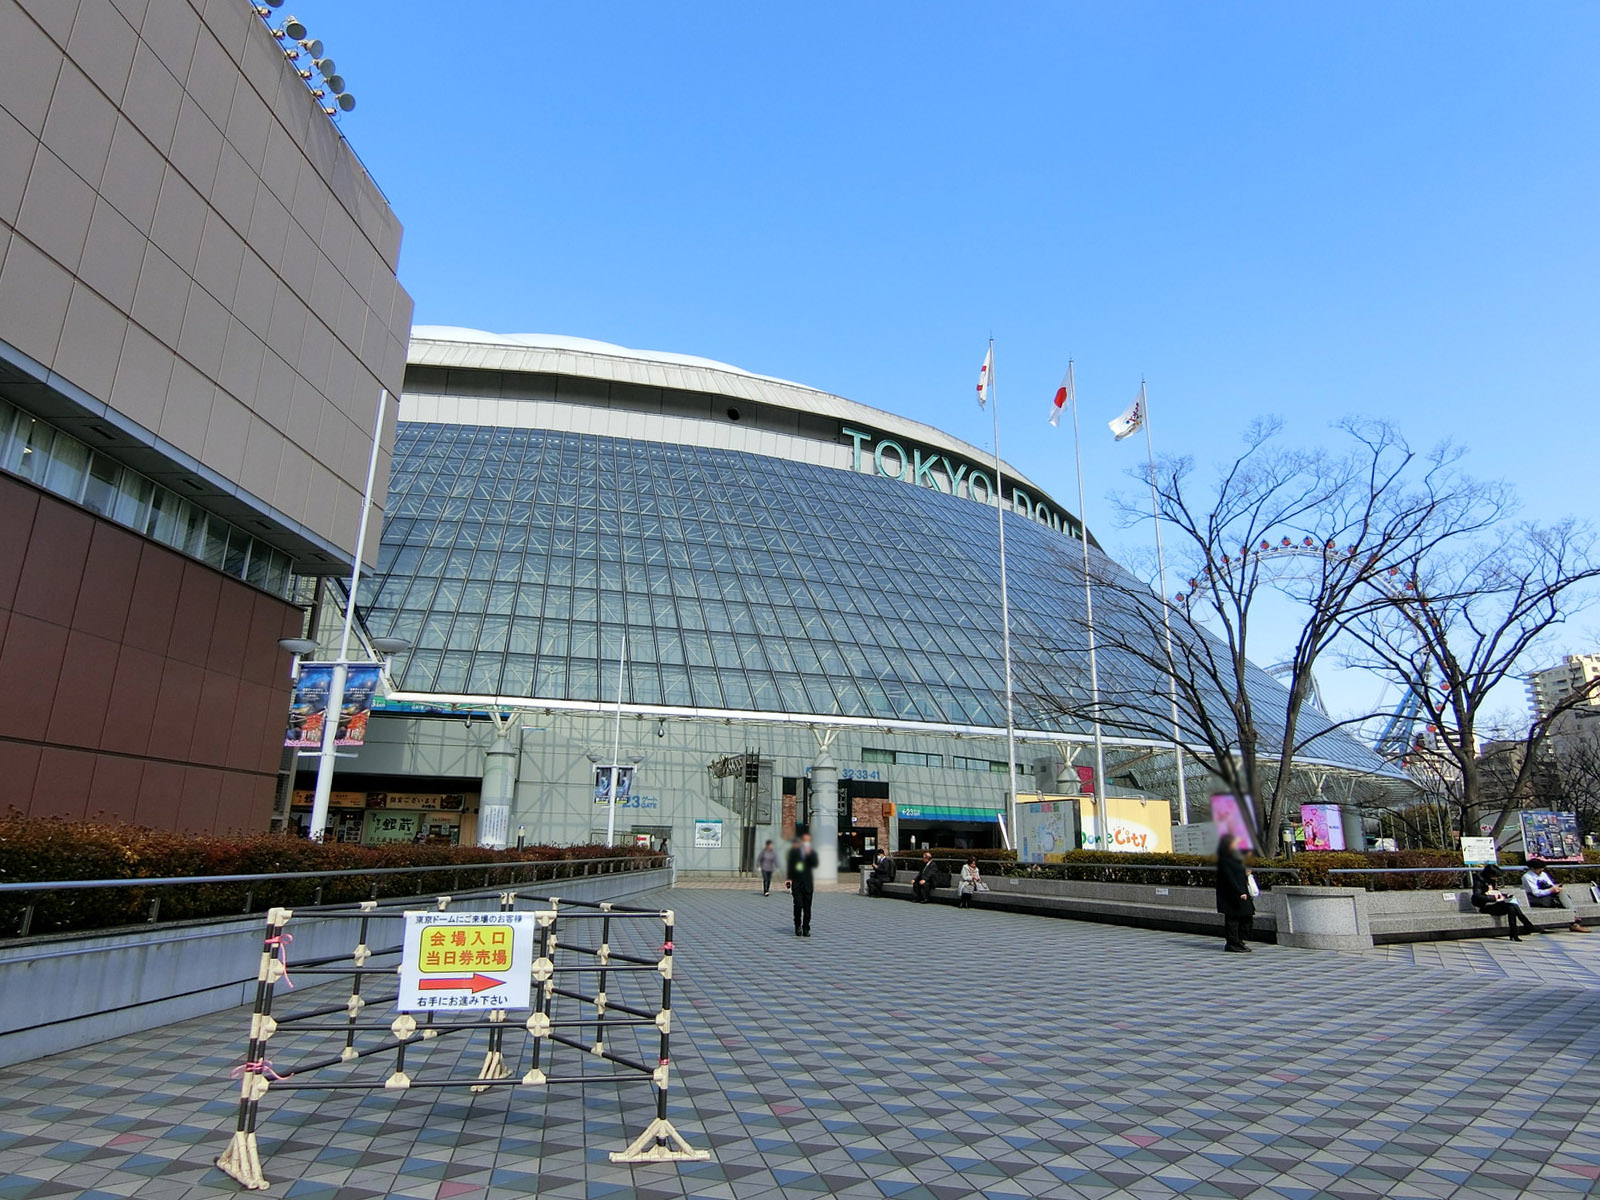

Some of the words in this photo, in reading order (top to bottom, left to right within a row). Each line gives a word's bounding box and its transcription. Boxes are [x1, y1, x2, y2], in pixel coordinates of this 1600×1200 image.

[842, 427, 994, 506] TOKYO
[1114, 829, 1147, 848] City
[416, 914, 522, 924] 東京ドームにご来場のお客様
[430, 930, 505, 947] 会場入口
[425, 949, 508, 966] 当日券売場
[417, 995, 509, 1007] 右手にお進み下さい
